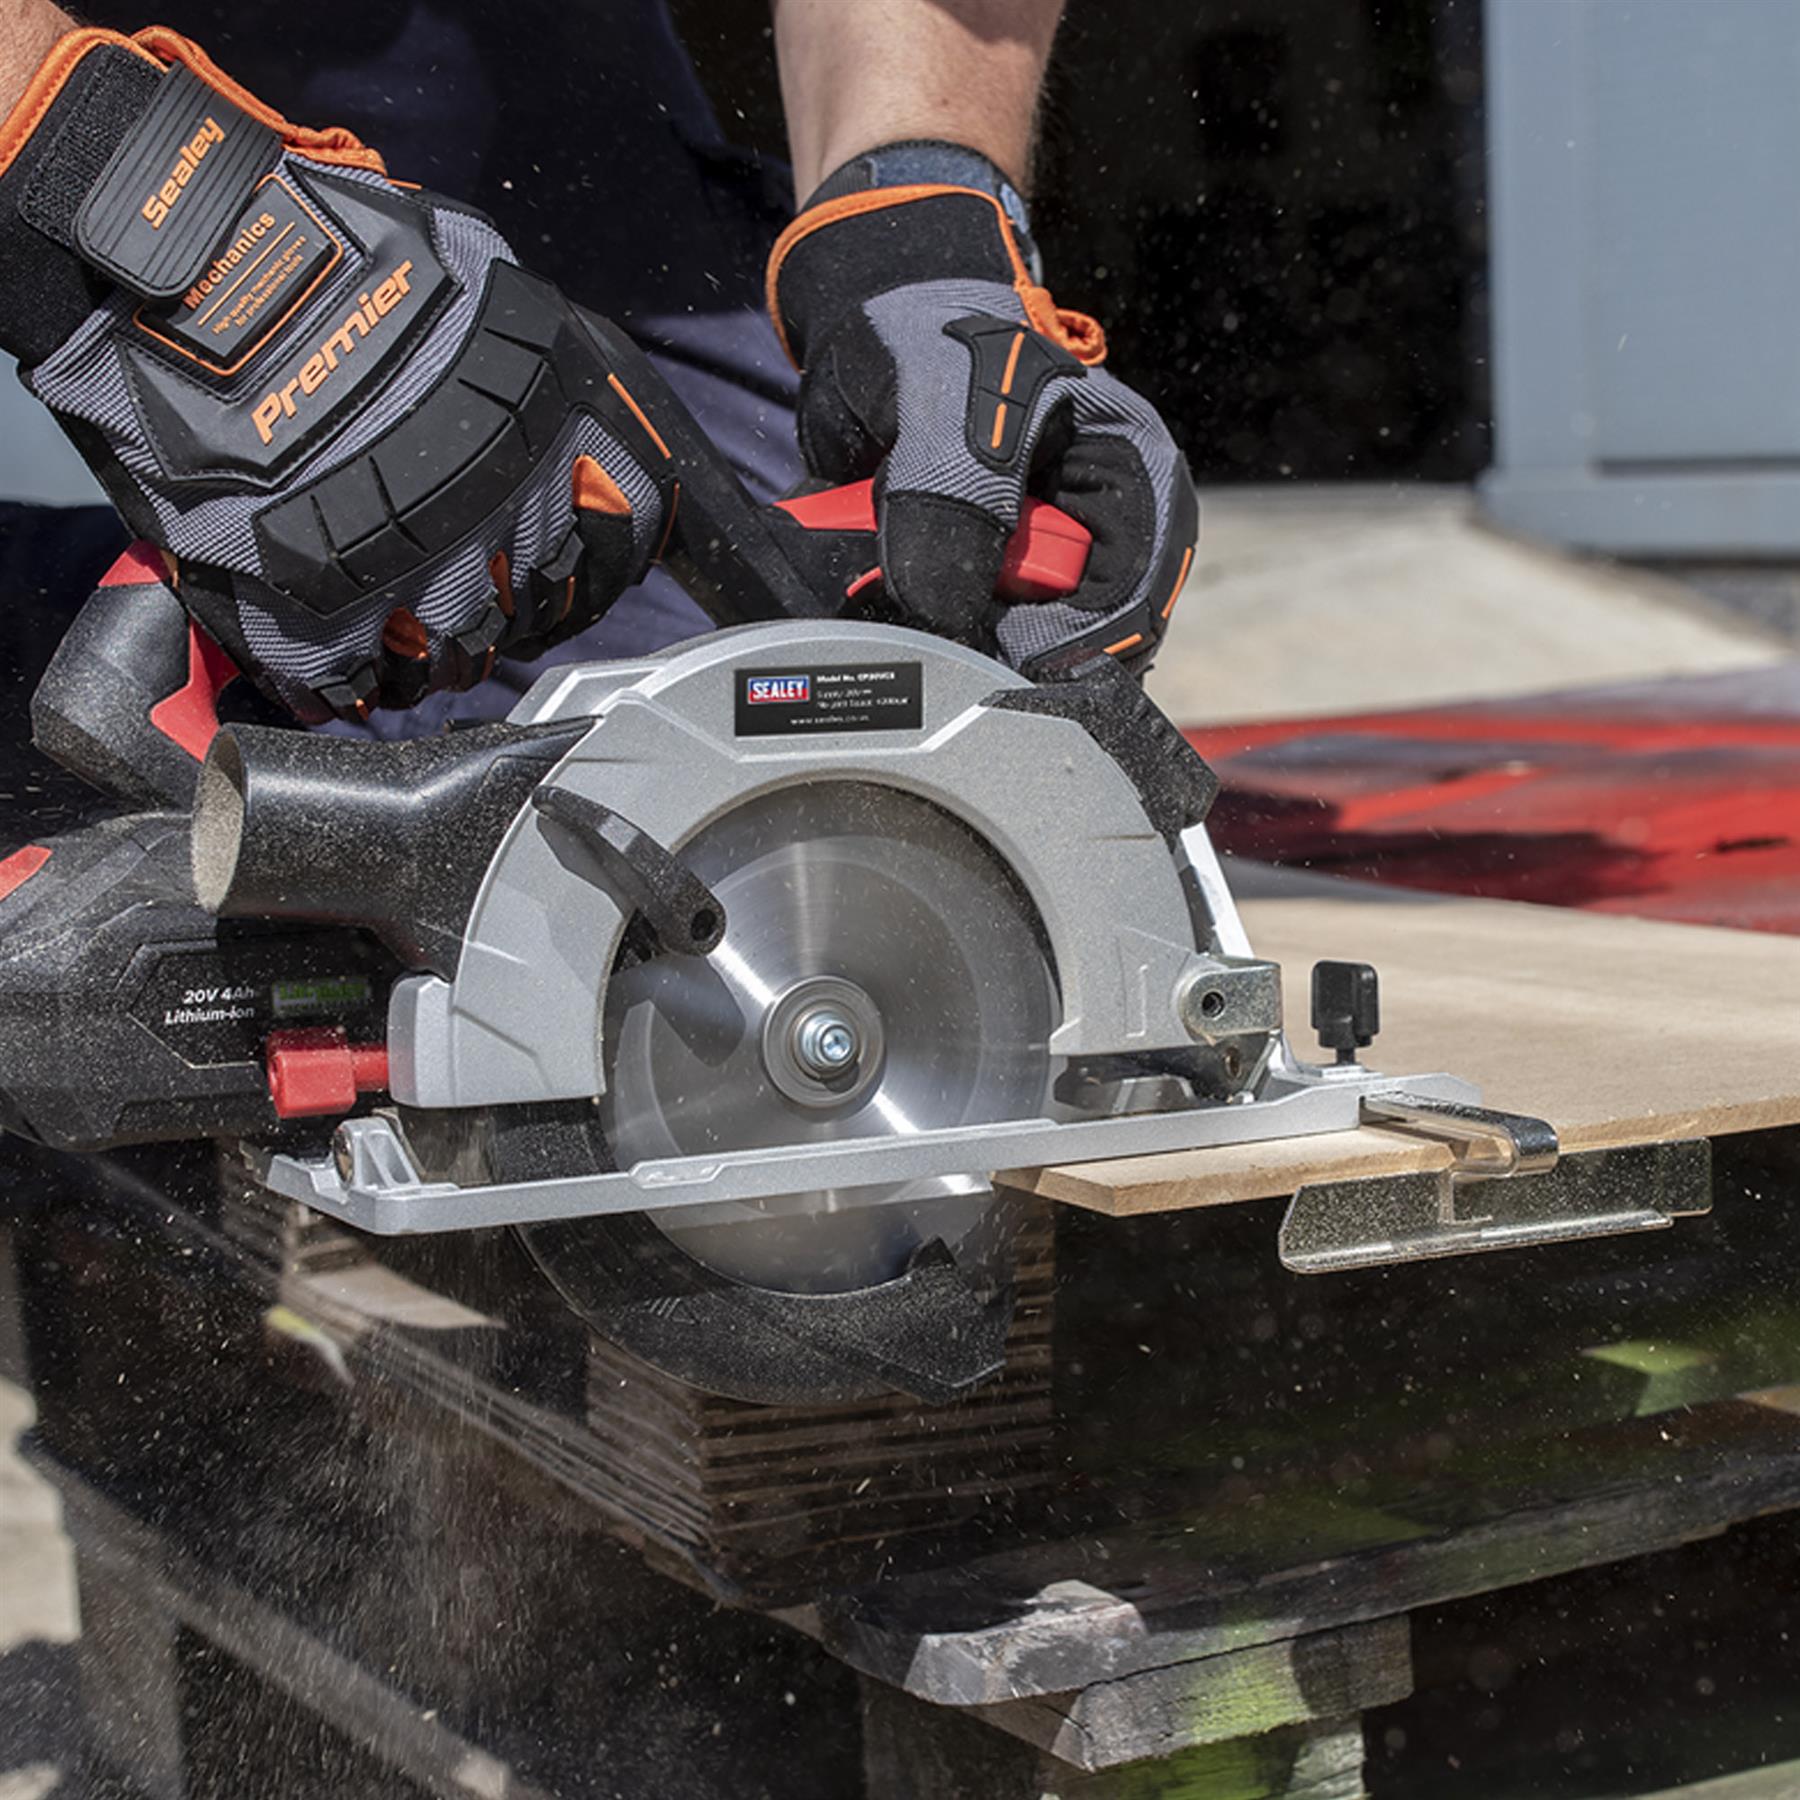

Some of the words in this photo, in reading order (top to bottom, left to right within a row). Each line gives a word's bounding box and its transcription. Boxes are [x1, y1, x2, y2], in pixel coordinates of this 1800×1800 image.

[141, 117, 225, 229] Sealey
[183, 213, 276, 310] Mechanics
[251, 259, 414, 445] Premier
[752, 680, 805, 699] SEALEY
[816, 674, 841, 683] Model
[183, 988, 219, 1004] 20V
[221, 986, 254, 1001] 4Ah
